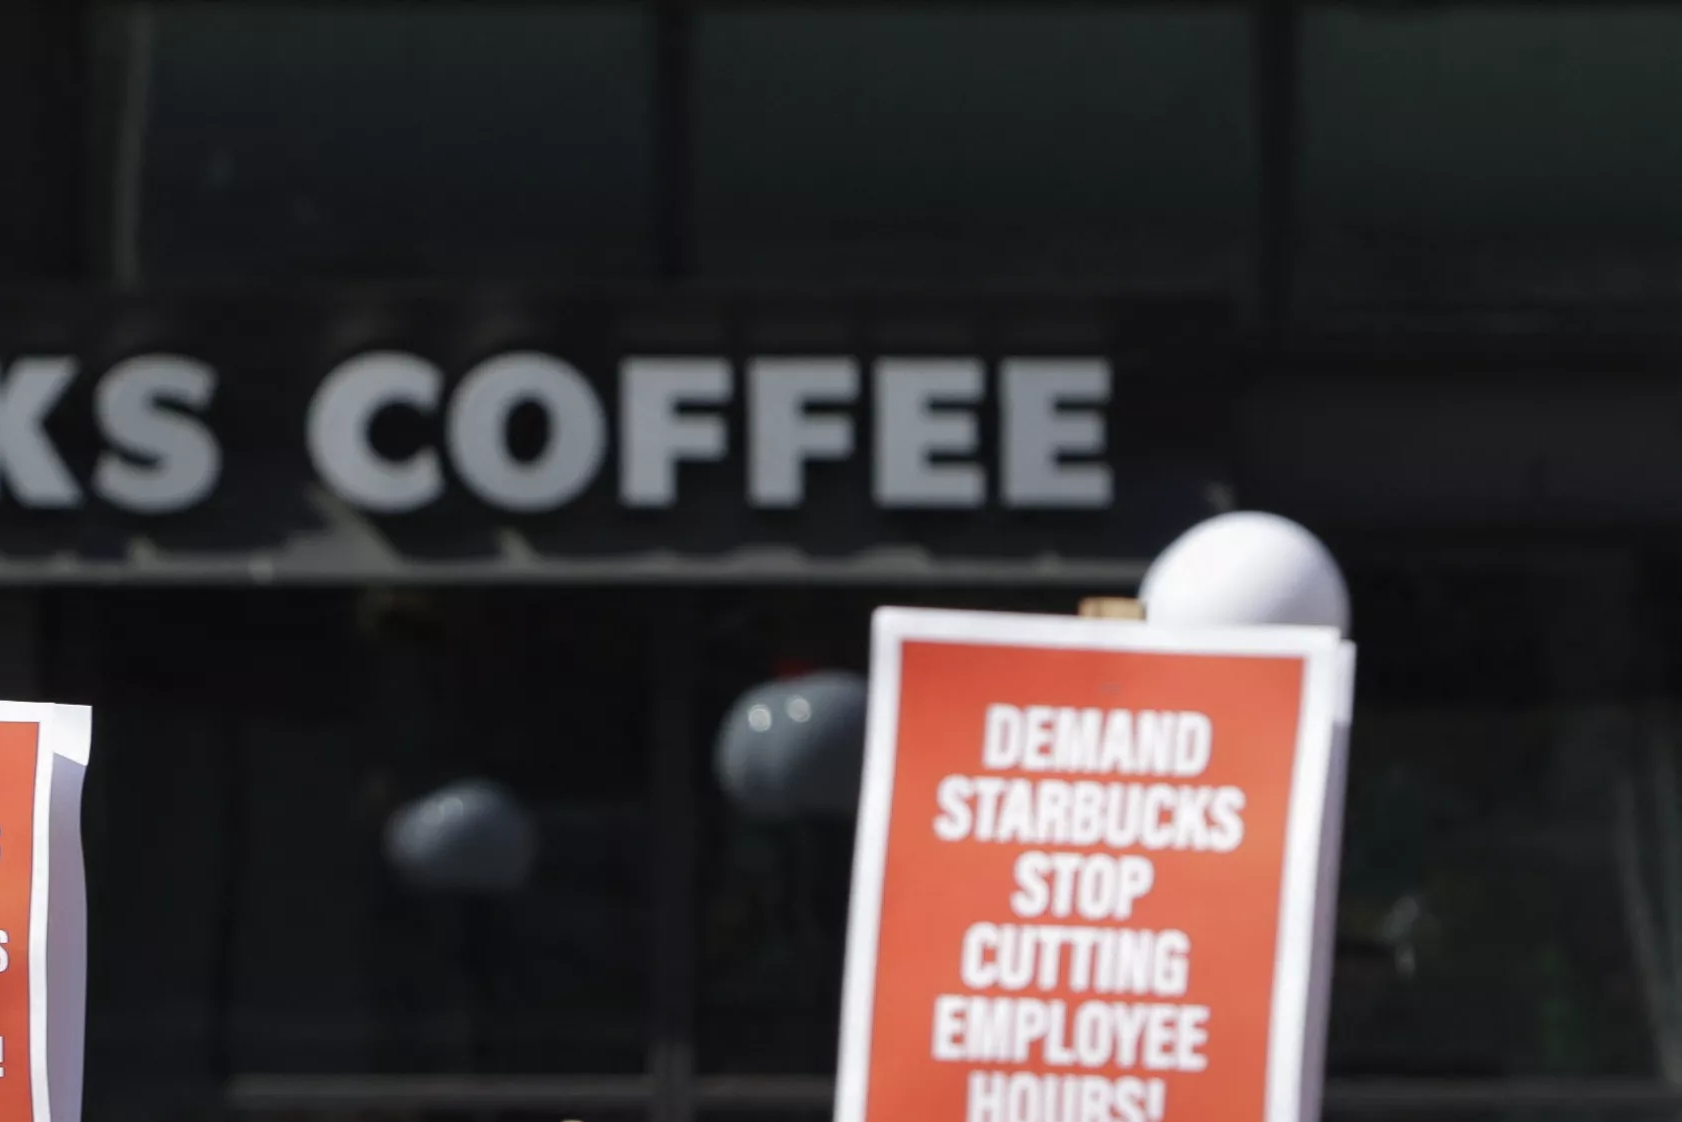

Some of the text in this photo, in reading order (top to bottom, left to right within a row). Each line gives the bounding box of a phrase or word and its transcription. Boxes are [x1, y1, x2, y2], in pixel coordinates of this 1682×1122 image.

[309, 355, 1111, 508] COFFEE
[985, 706, 1210, 775] DEMAND
[936, 777, 1244, 851] STARBUCKS
[1013, 852, 1153, 918] STOP
[963, 923, 1188, 994] CUTTING
[934, 995, 1208, 1070] EMPLOYEE
